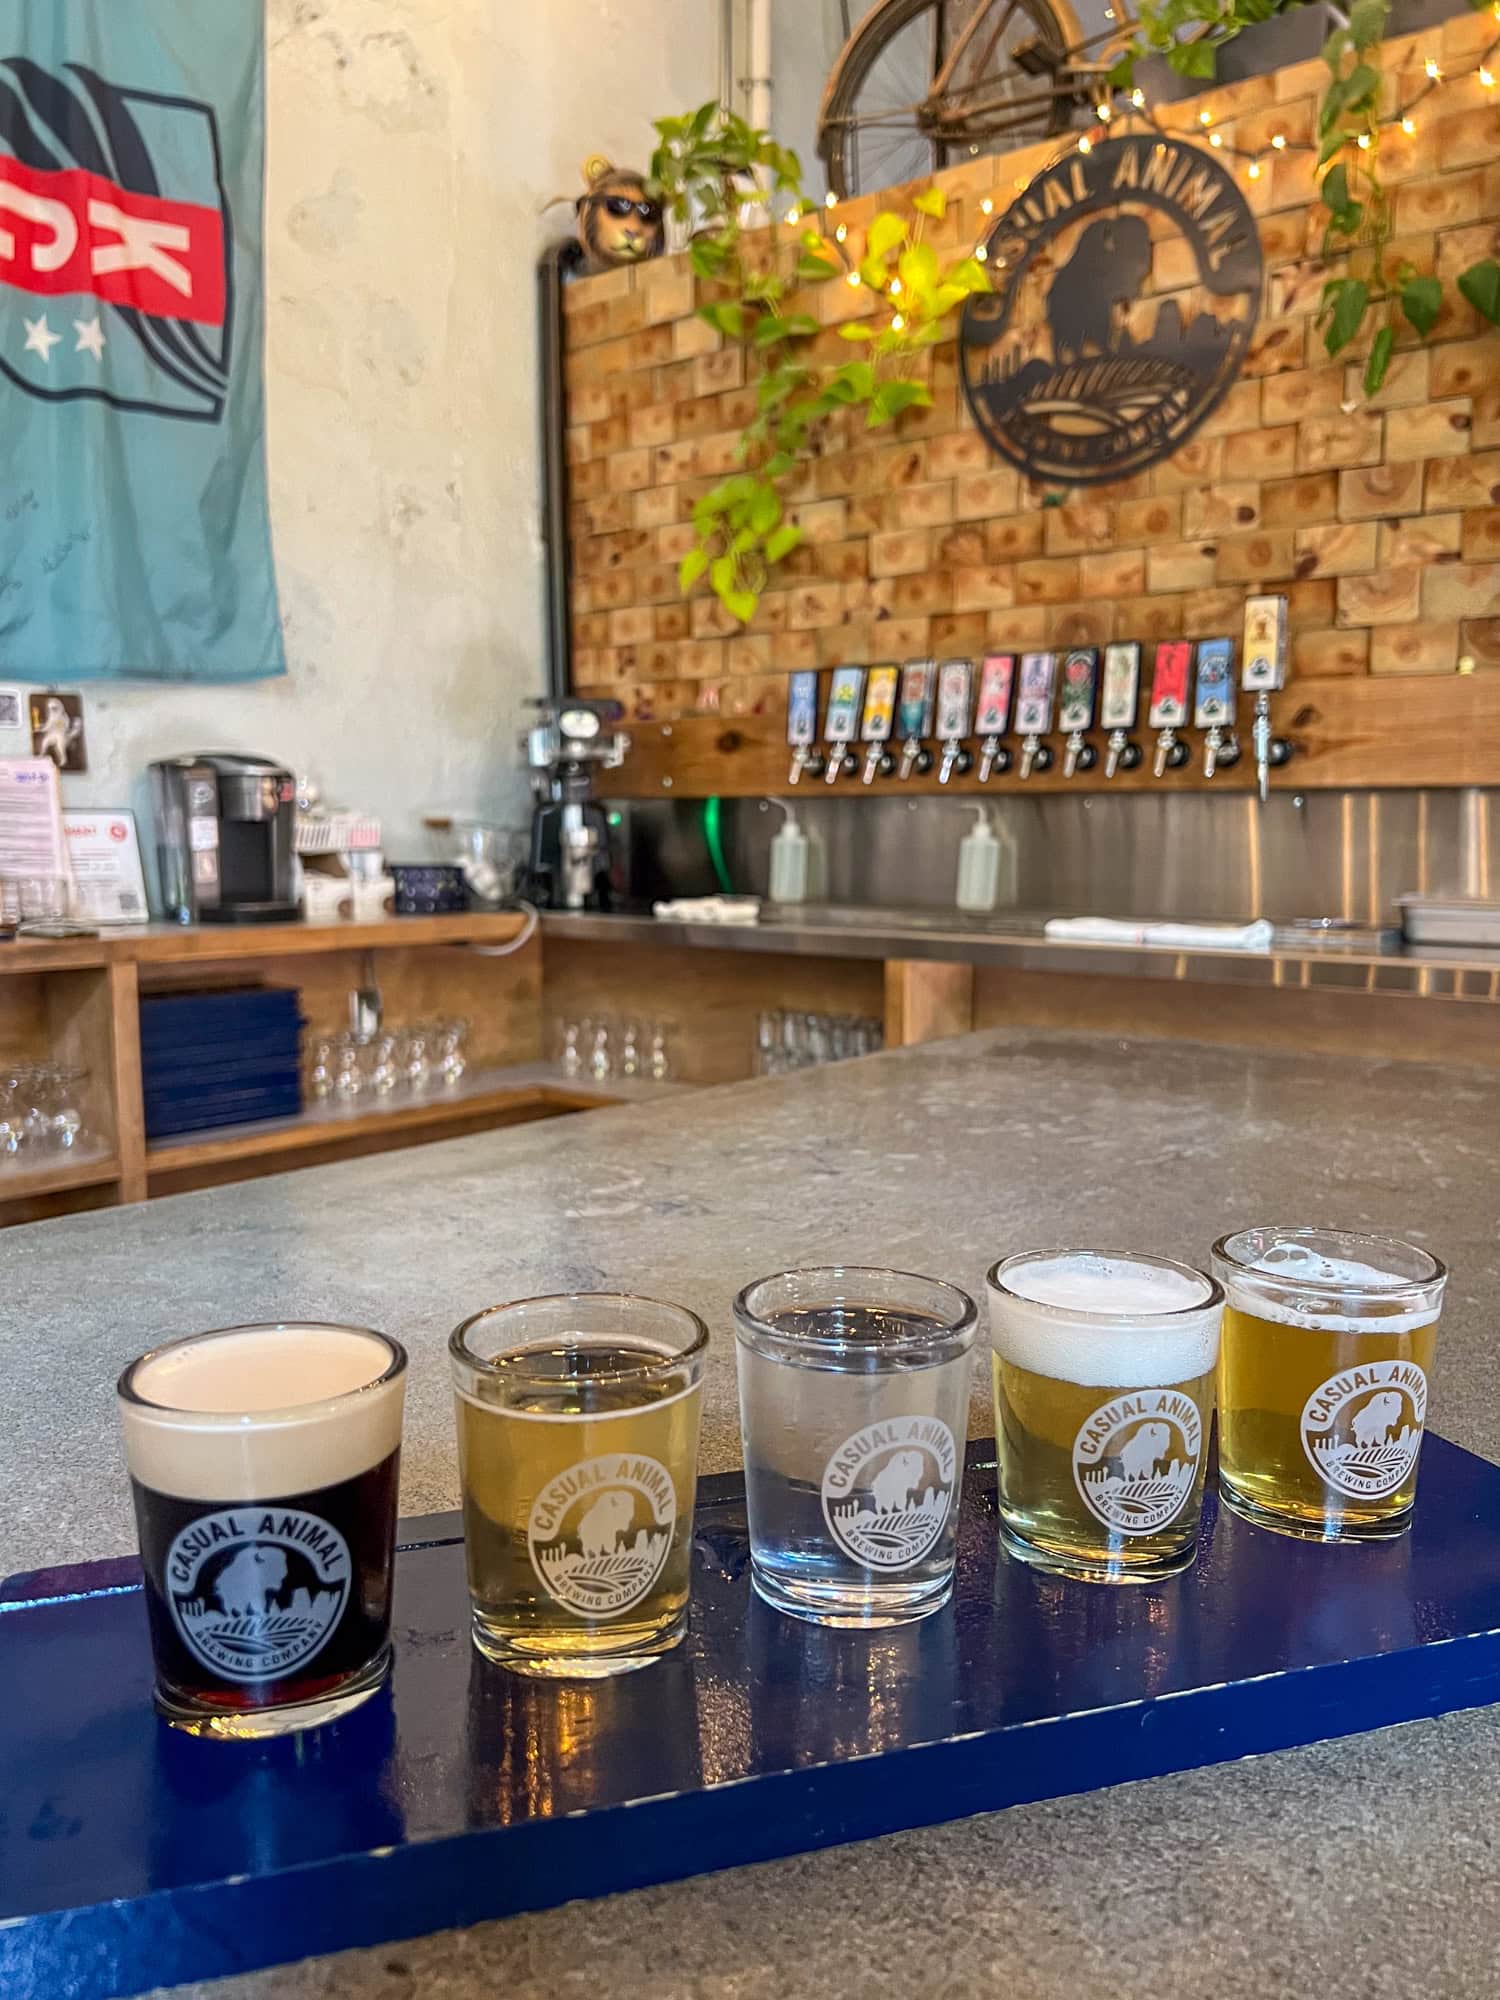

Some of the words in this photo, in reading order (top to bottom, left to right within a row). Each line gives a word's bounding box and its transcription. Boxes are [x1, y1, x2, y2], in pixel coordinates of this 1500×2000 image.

[1113, 143, 1240, 273] ANIMAL
[1308, 1367, 1381, 1424] CASUAL
[1388, 1365, 1426, 1414] ANIMAL
[1080, 1397, 1148, 1455] CASUAL
[1155, 1394, 1200, 1448] ANIMAL
[828, 1424, 899, 1488] CASUAL
[907, 1421, 954, 1473] ANIMAL
[1325, 1460, 1372, 1489] BREWING
[1376, 1454, 1412, 1489] COMPANY
[535, 1463, 608, 1531] CASUAL
[615, 1459, 673, 1515] ANIMAL
[1095, 1494, 1139, 1524] BREWING
[1143, 1489, 1183, 1524] COMPANY
[172, 1515, 245, 1583] CASUAL
[258, 1513, 344, 1572] ANIMAL
[846, 1528, 893, 1560] BREWING
[898, 1517, 940, 1559] COMPANY
[553, 1574, 602, 1606] BREWING
[607, 1563, 654, 1605] COMPANY
[195, 1630, 254, 1668] BREWING
[262, 1621, 324, 1668] COMPANY
